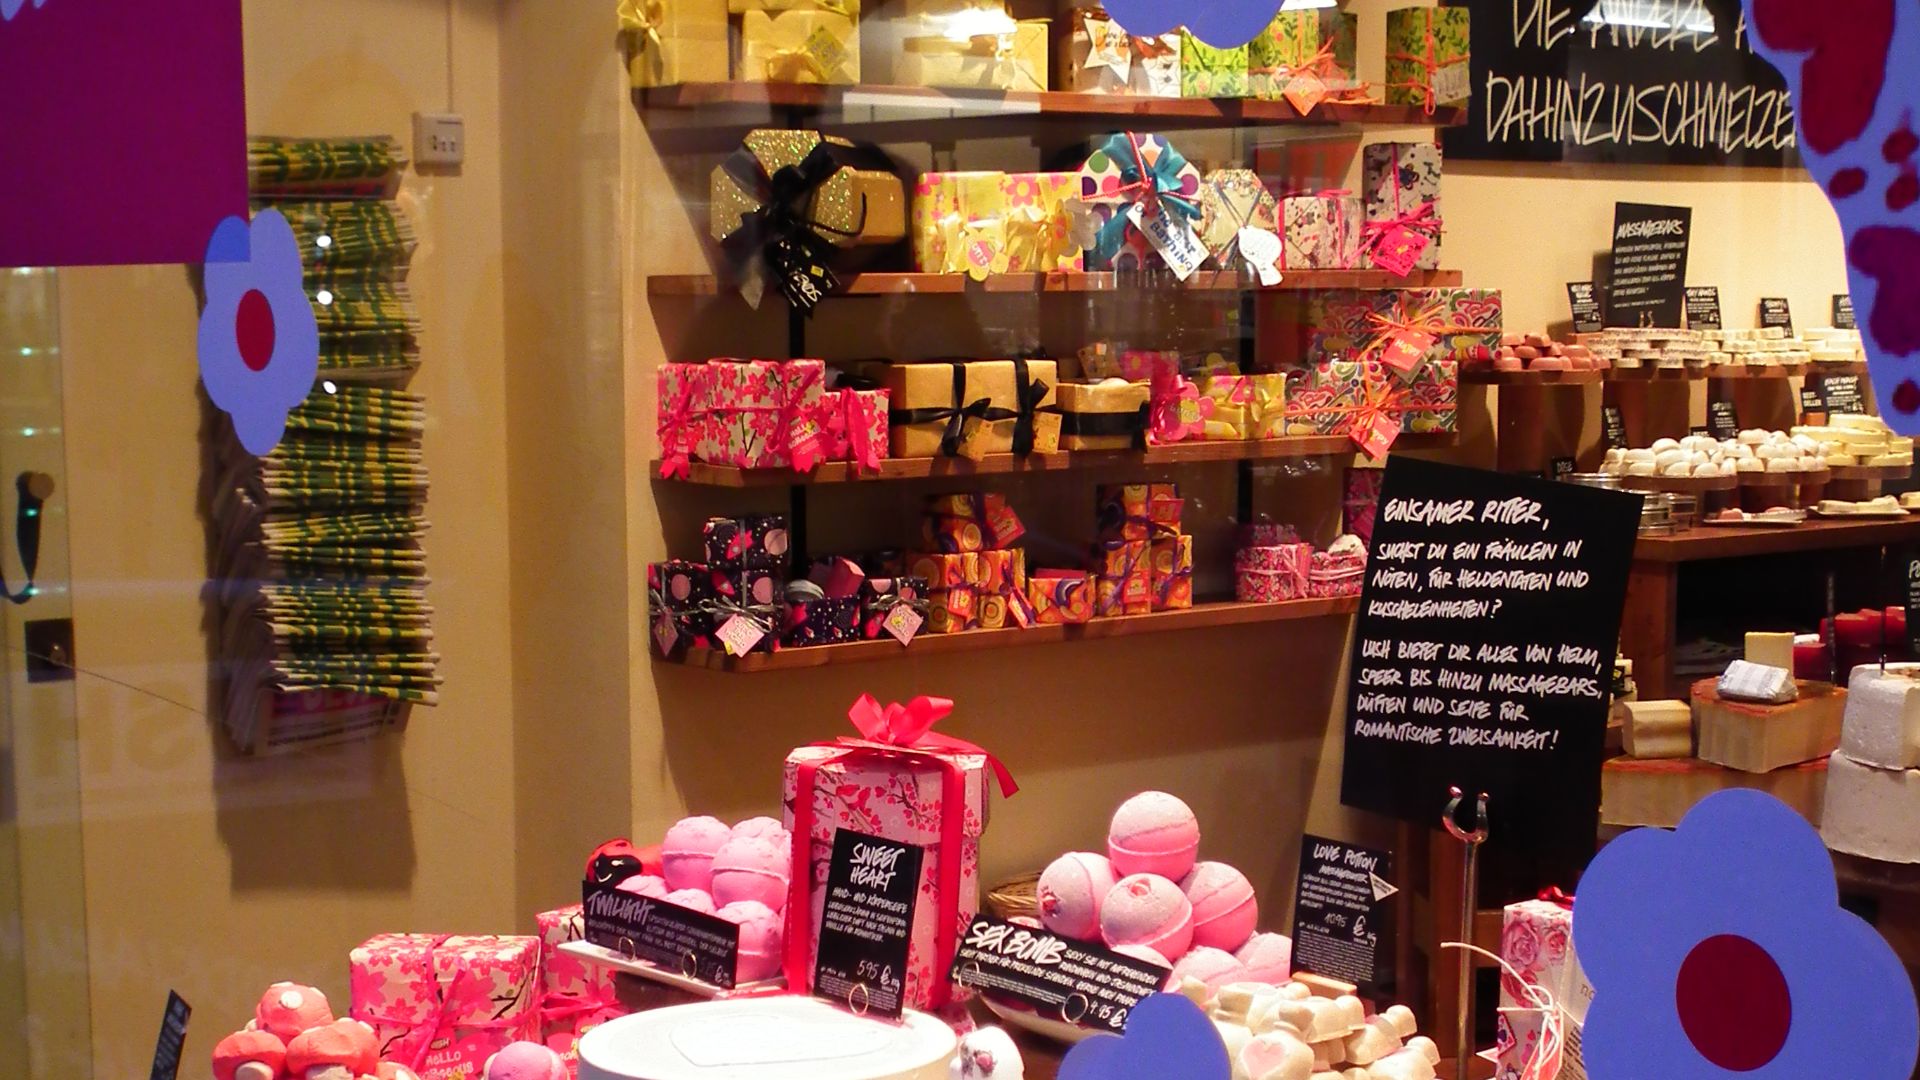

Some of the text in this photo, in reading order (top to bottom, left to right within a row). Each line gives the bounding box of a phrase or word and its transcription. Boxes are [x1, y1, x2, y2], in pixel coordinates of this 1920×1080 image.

[1485, 71, 1796, 154] DAHINZUSCHMELZE
[1383, 497, 1549, 531] EINSAMER RITTER,
[1376, 537, 1582, 564] SUCHST DU EIN FRÄULEIN IN
[1372, 566, 1589, 593] NÖTEN, FÜR HELDENTATEN UND
[1362, 639, 1603, 674] LUSH BIETET DIR ALLES VON HELM,
[1357, 668, 1603, 699] SPEER BIS HINZU MASSAGEBARS,
[1357, 692, 1530, 721] DÜFTEN UND SEIFE FÜR
[1354, 719, 1442, 745] ROMANTISCHE
[849, 842, 905, 872] SWEET
[1313, 843, 1378, 872] LOVE POTION
[849, 865, 897, 893] HEART
[587, 890, 656, 926] TWILIGHT
[965, 921, 1068, 965] SEX BOMB
